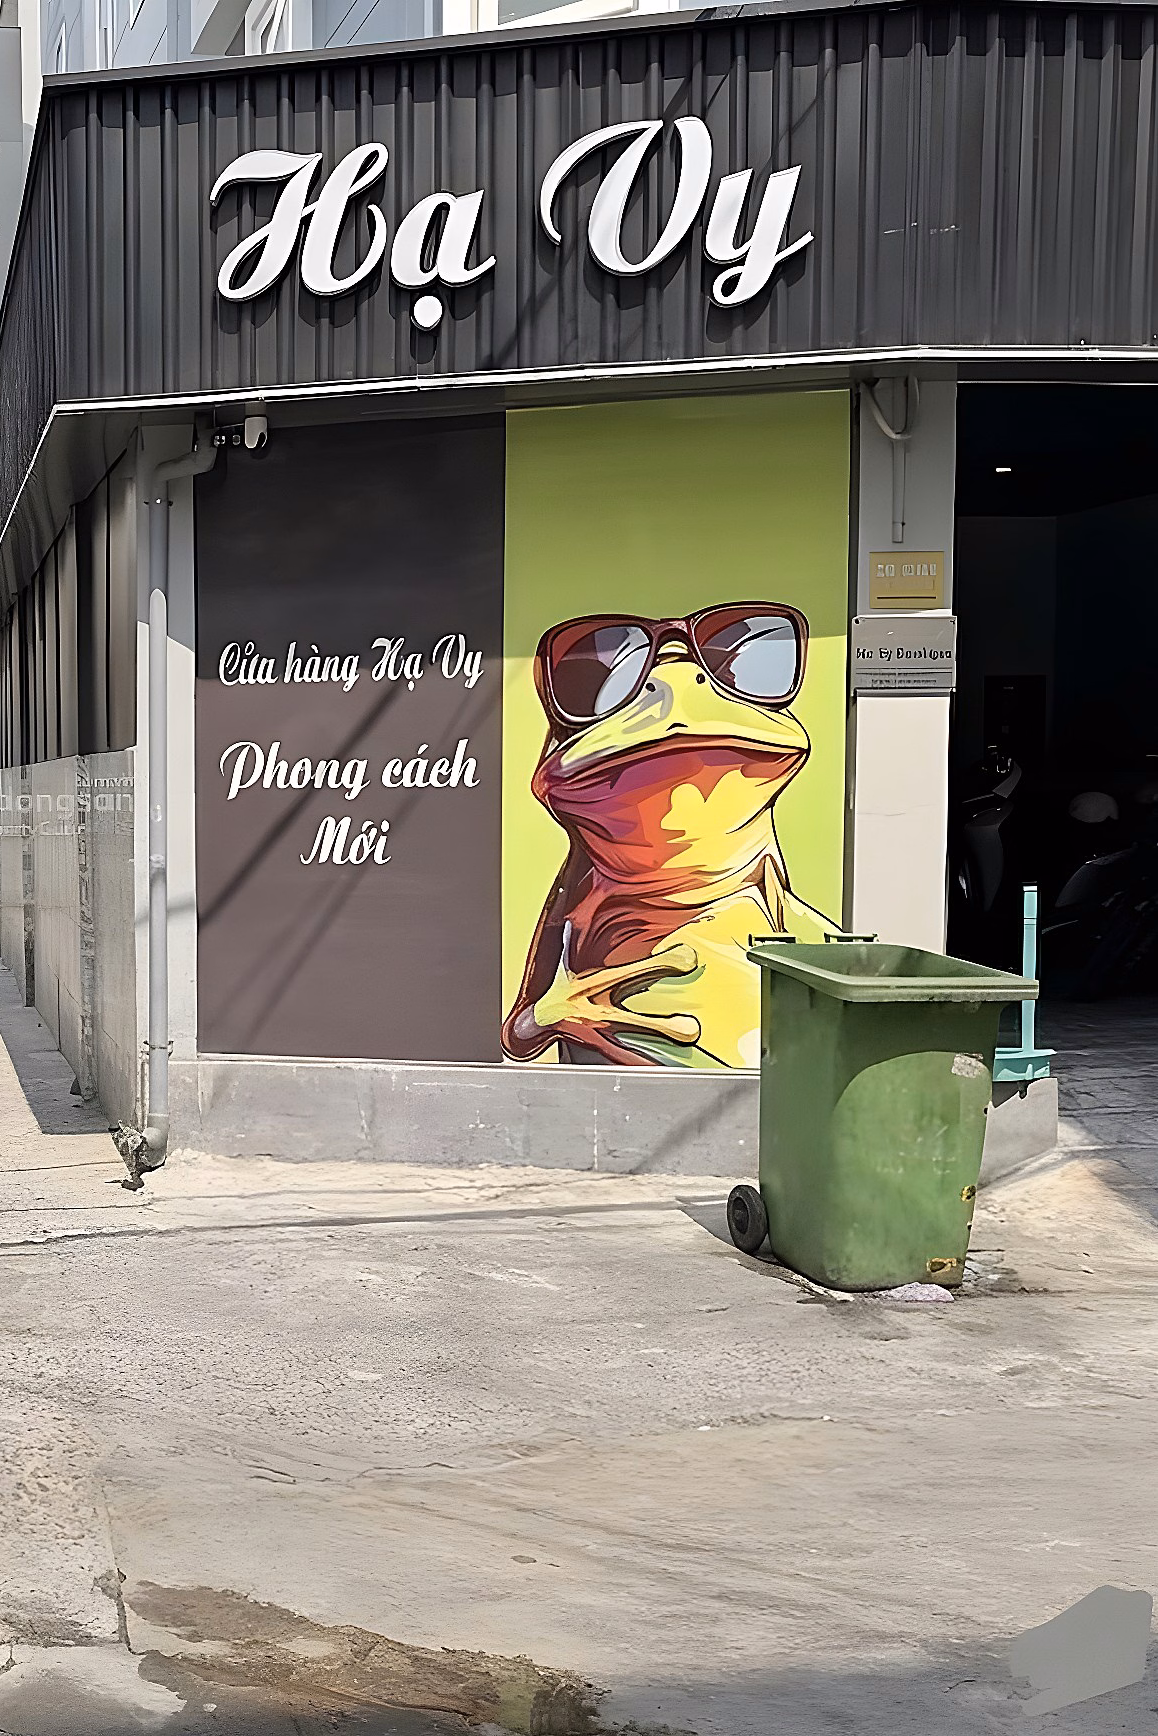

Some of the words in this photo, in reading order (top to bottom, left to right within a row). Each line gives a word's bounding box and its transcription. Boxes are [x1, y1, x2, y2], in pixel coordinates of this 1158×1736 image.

[210, 141, 497, 332] Hạ
[539, 116, 815, 309] Vy
[218, 641, 279, 687] Cửa
[283, 641, 360, 693] hàng
[371, 637, 424, 692] Hạ
[430, 633, 485, 689] Vy
[219, 741, 371, 801] Phong
[381, 738, 481, 789] cách
[299, 814, 392, 866] Mới
